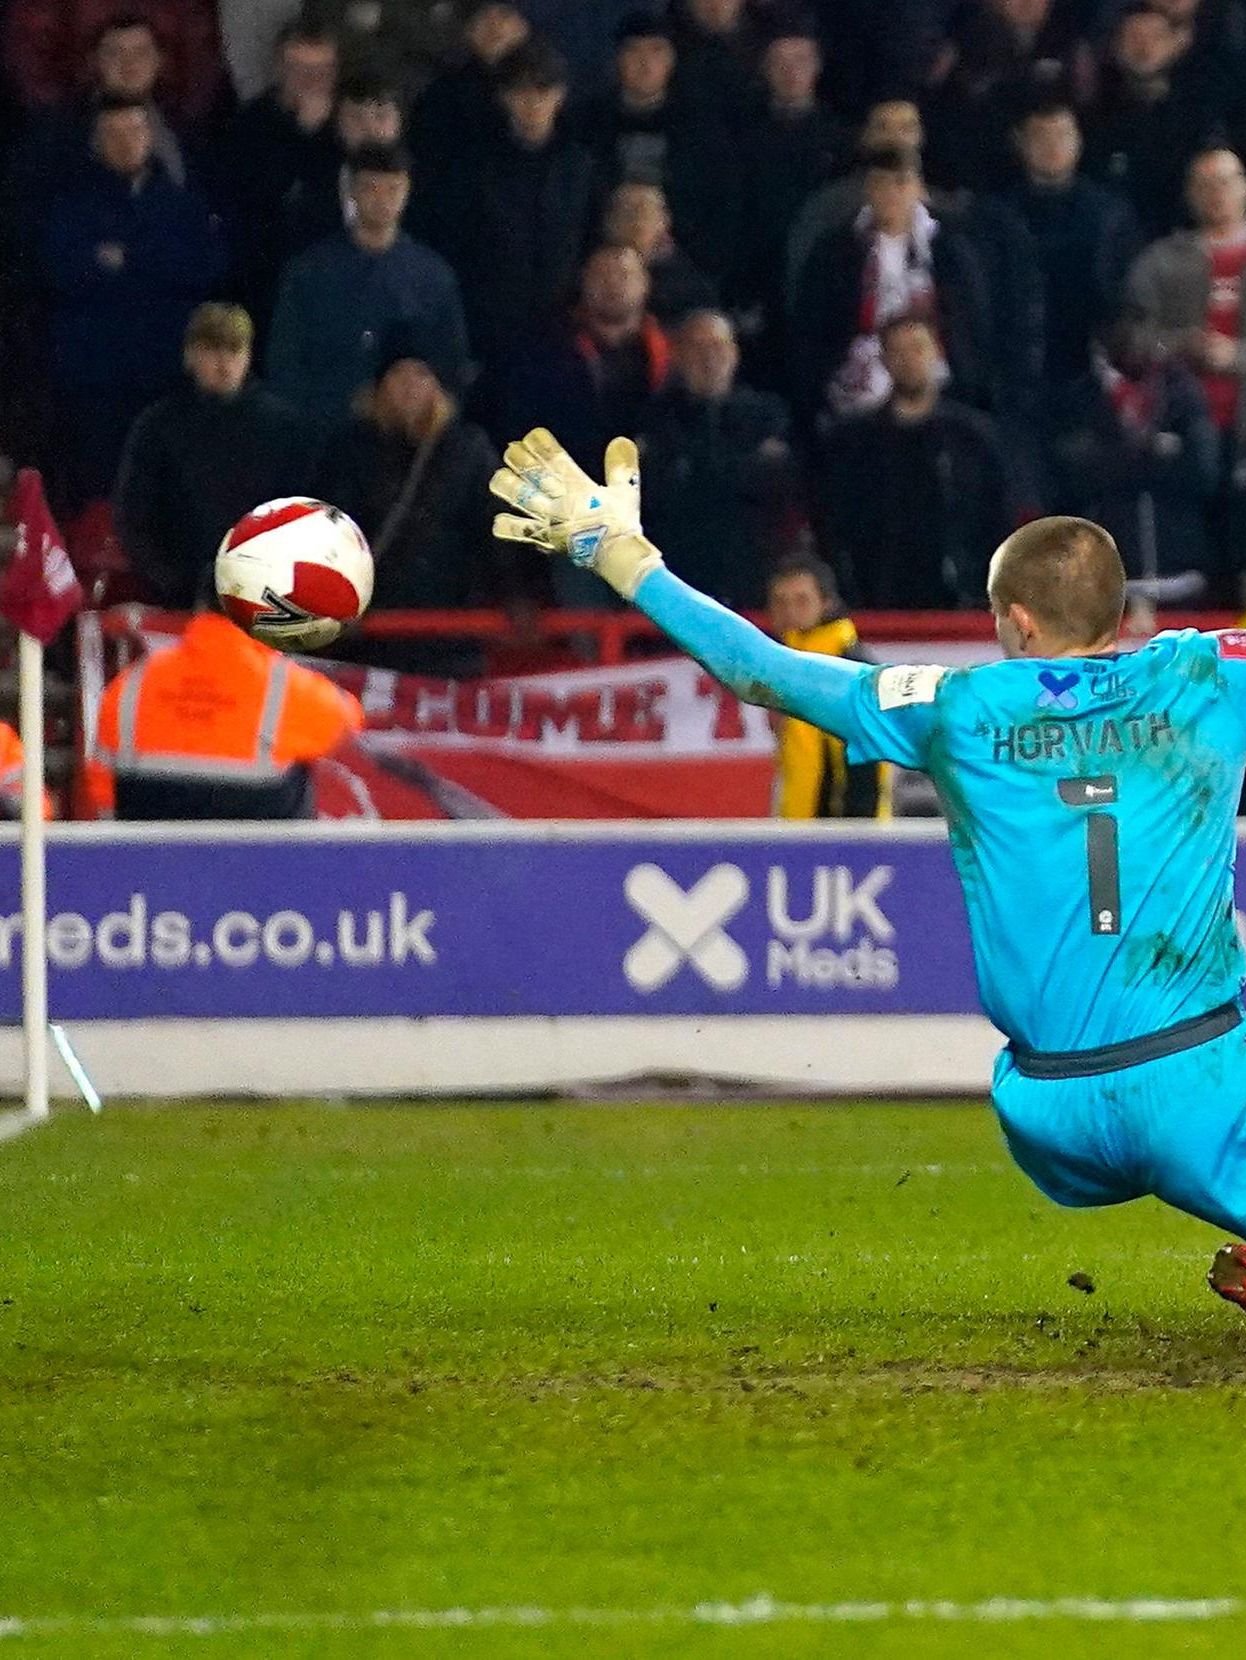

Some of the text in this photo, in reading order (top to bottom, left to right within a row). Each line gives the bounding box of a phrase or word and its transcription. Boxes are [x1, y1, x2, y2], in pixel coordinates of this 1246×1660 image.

[992, 708, 1174, 763] HORVATH
[1056, 775, 1121, 935] 1
[766, 864, 897, 943] UK
[766, 938, 900, 990] Meds
